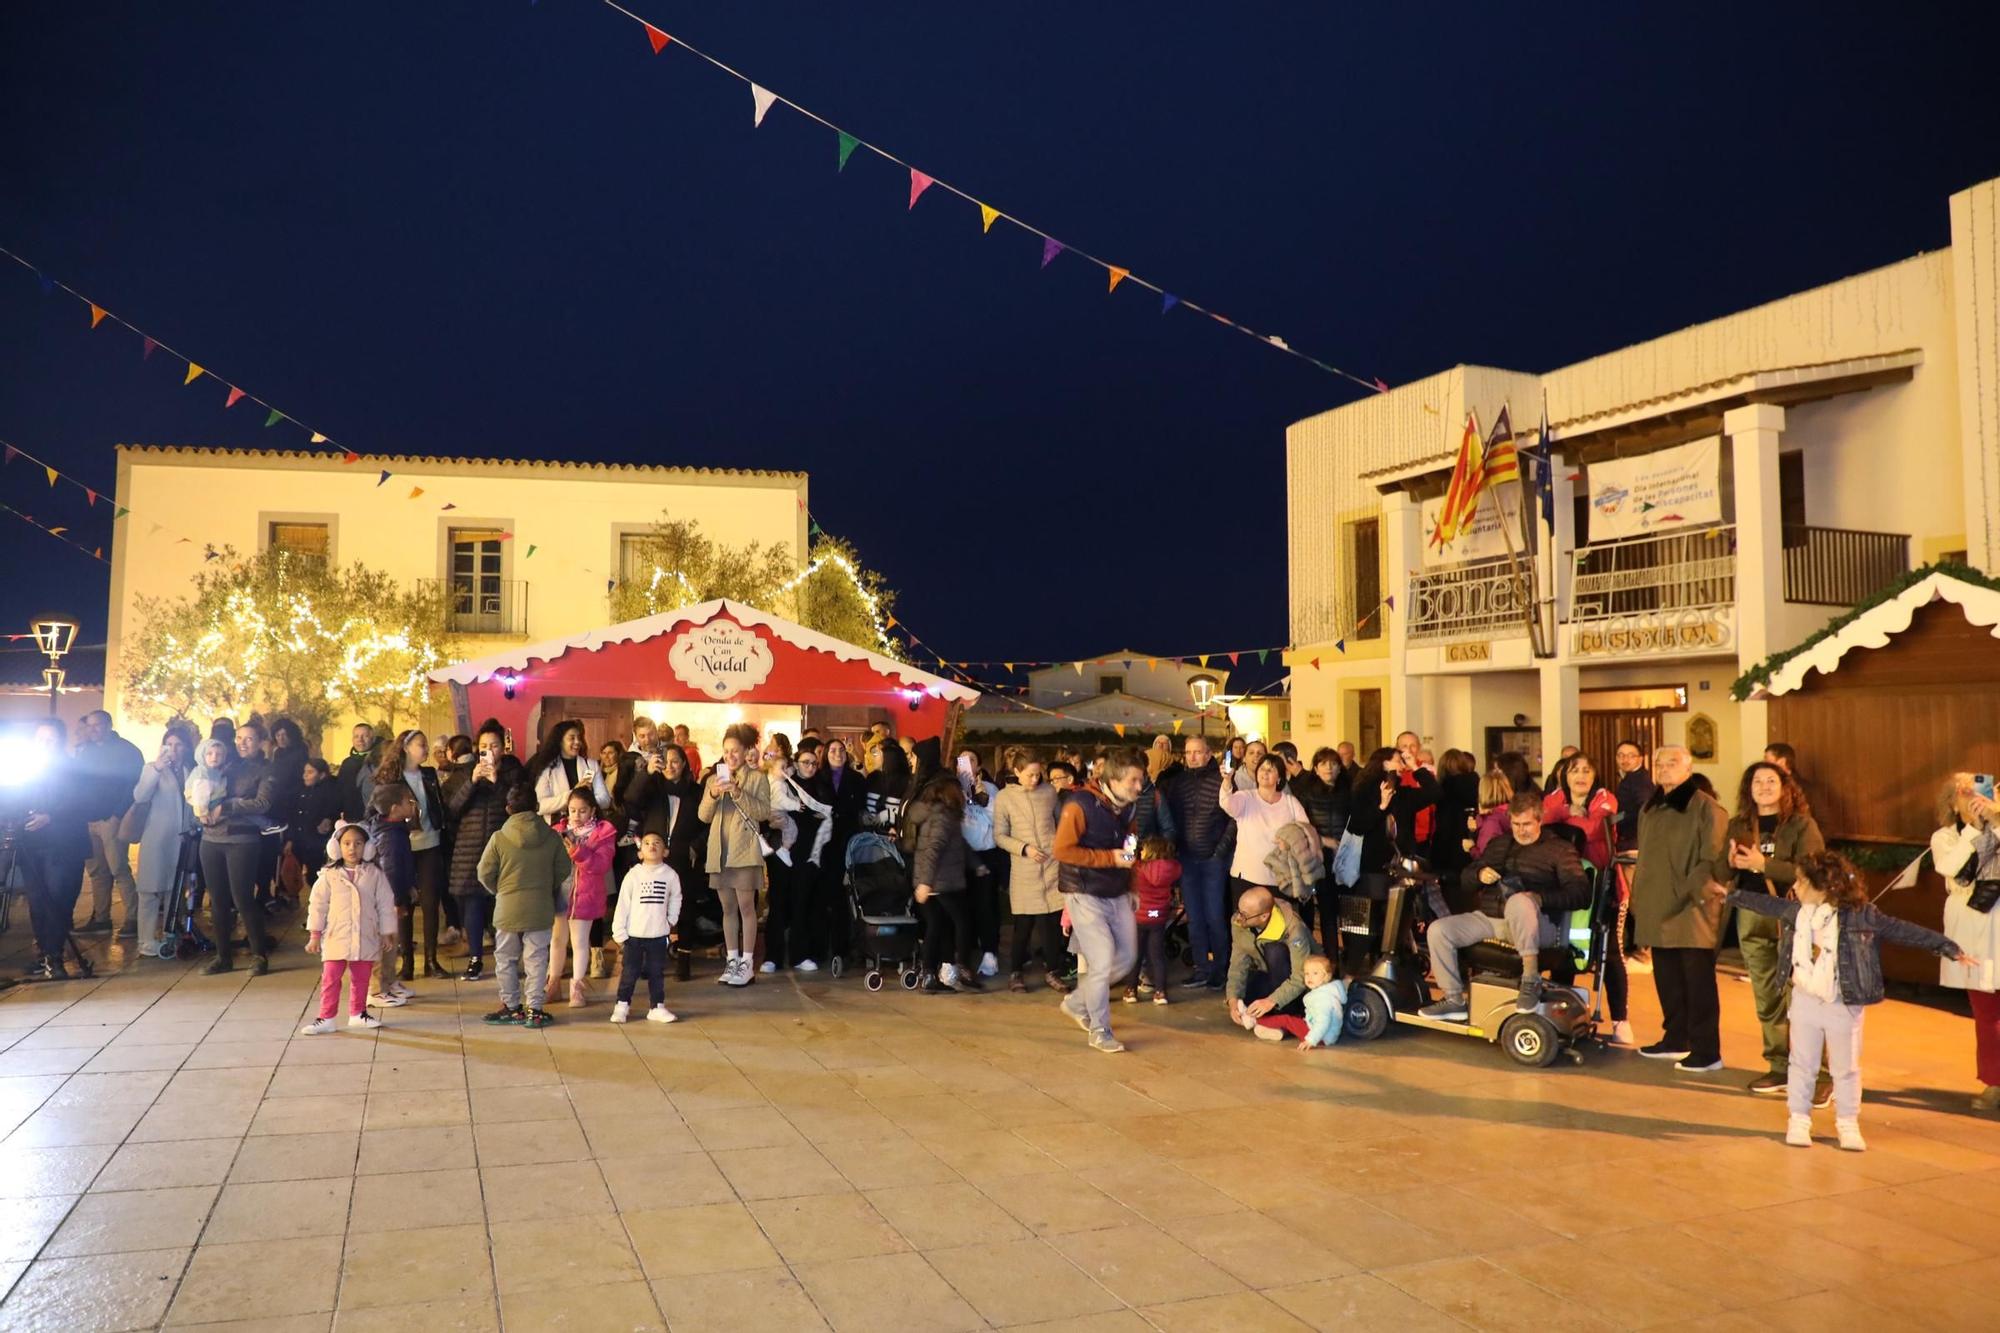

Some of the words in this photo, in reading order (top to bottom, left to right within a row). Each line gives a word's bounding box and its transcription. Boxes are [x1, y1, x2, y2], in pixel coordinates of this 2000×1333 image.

[1409, 571, 1531, 622] Bones
[1573, 600, 1731, 656] Festes
[712, 646, 732, 656] Can
[734, 637, 745, 646] de
[1449, 644, 1489, 661] CASA
[694, 655, 749, 677] Nadal
